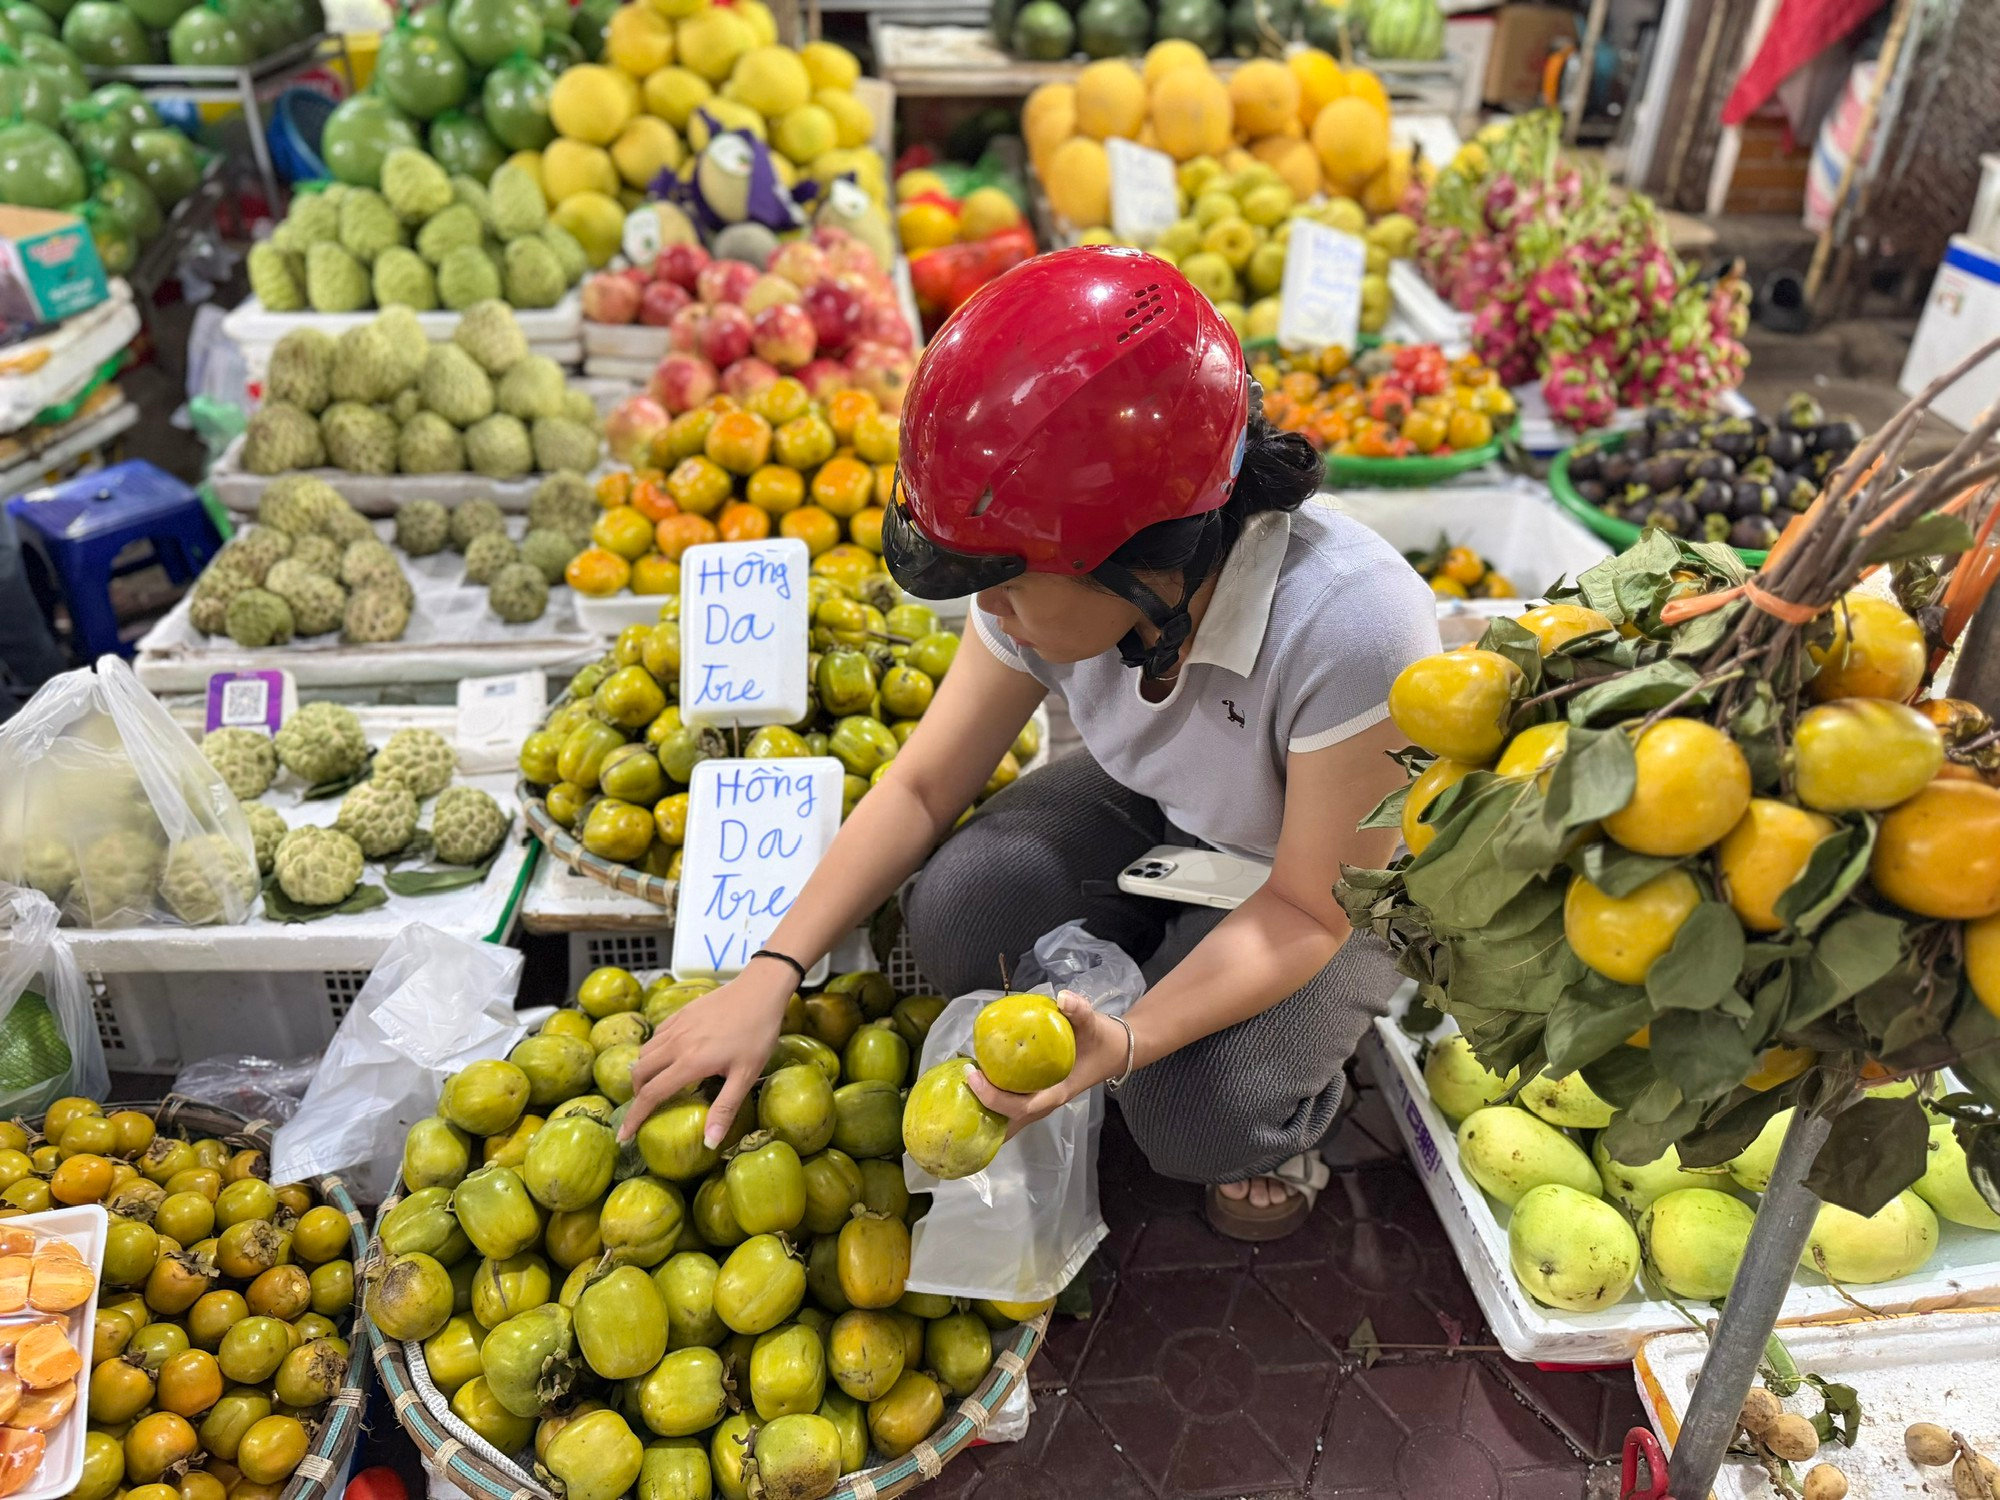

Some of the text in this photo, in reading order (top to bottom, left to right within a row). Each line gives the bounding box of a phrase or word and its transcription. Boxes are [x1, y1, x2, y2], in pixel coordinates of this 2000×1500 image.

[698, 549, 791, 600] Hồng
[705, 604, 775, 645] Da
[716, 766, 818, 818] Hồng
[719, 819, 803, 863] Da
[704, 931, 767, 972] Vi
